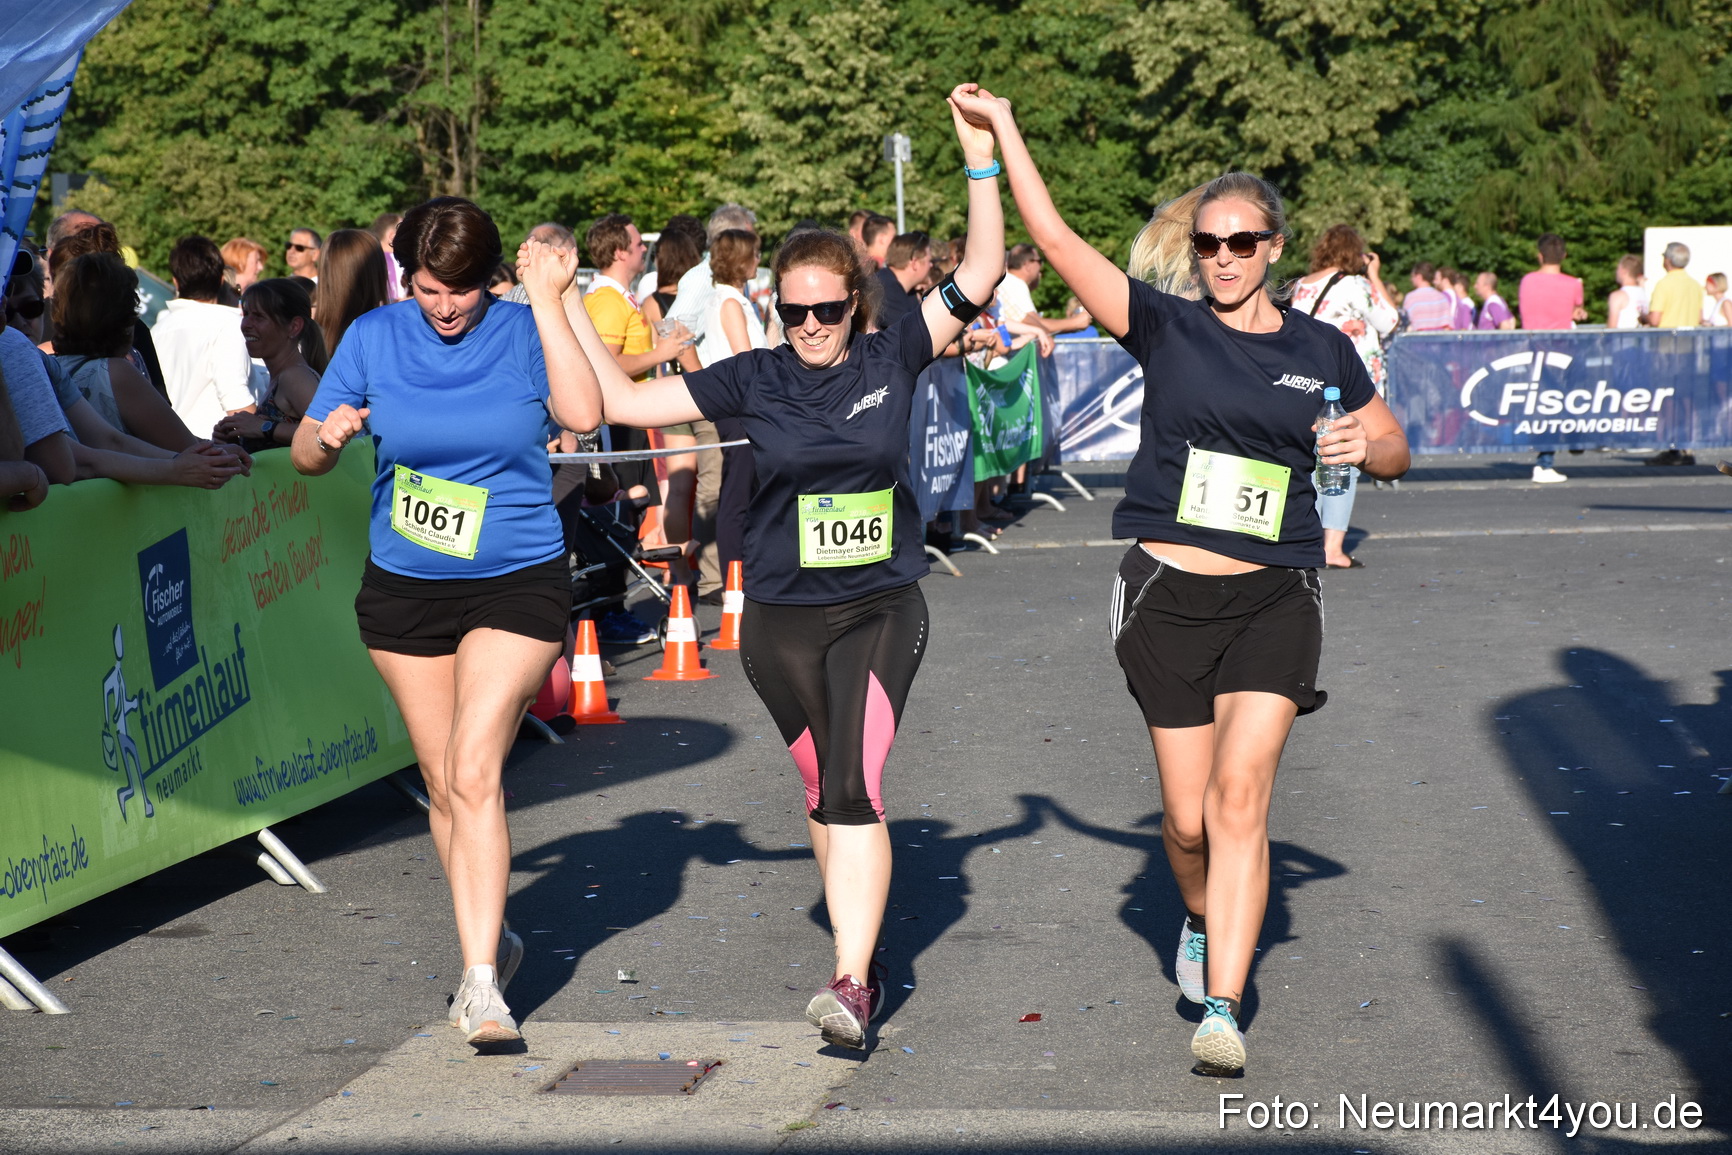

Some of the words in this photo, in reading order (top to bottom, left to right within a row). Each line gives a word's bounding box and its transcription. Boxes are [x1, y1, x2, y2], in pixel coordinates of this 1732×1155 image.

[1273, 373, 1311, 391] JURA
[1499, 380, 1675, 415] Fischer
[1514, 417, 1658, 434] AUTOMOBILE
[1196, 478, 1269, 517] 151
[402, 495, 466, 536] 1061
[404, 519, 428, 535] Schießl
[427, 530, 456, 543] Claudia
[1232, 511, 1270, 527] Stephanie
[813, 517, 882, 547] 1046
[247, 549, 294, 611] laufen
[287, 516, 329, 591] länger!
[816, 547, 854, 557] Dietmayer
[855, 543, 881, 553] Sabrina
[817, 553, 847, 561] Lebenshilfe
[152, 579, 184, 615] Fischer
[157, 603, 183, 628] AUTOMOBILE
[138, 622, 252, 769] firmenlauf
[156, 745, 203, 803] neumarkt
[233, 716, 378, 807] www.firmenlauf-oberpfalz.de
